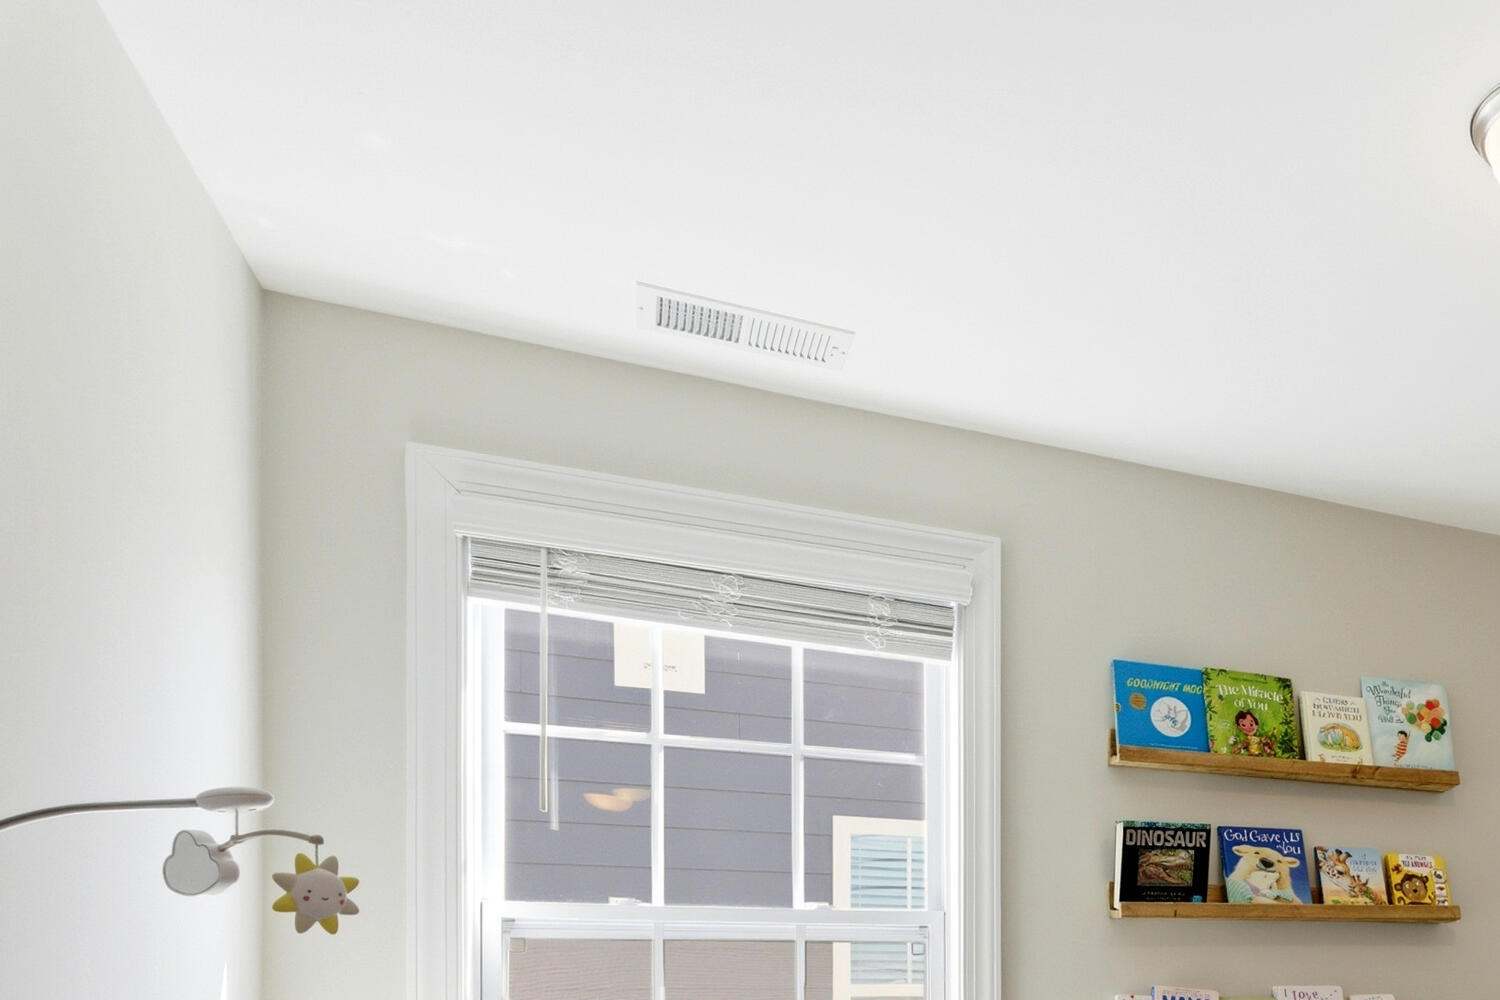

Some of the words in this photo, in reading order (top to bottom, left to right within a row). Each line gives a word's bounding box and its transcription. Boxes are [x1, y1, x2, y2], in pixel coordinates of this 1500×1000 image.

[1182, 684, 1203, 695] MOO
[1216, 684, 1239, 696] The
[1241, 685, 1284, 704] Miracle
[1247, 698, 1268, 711] You
[1125, 828, 1207, 848] DINOSAUR
[1223, 828, 1248, 842] God
[1249, 829, 1281, 843] Gave
